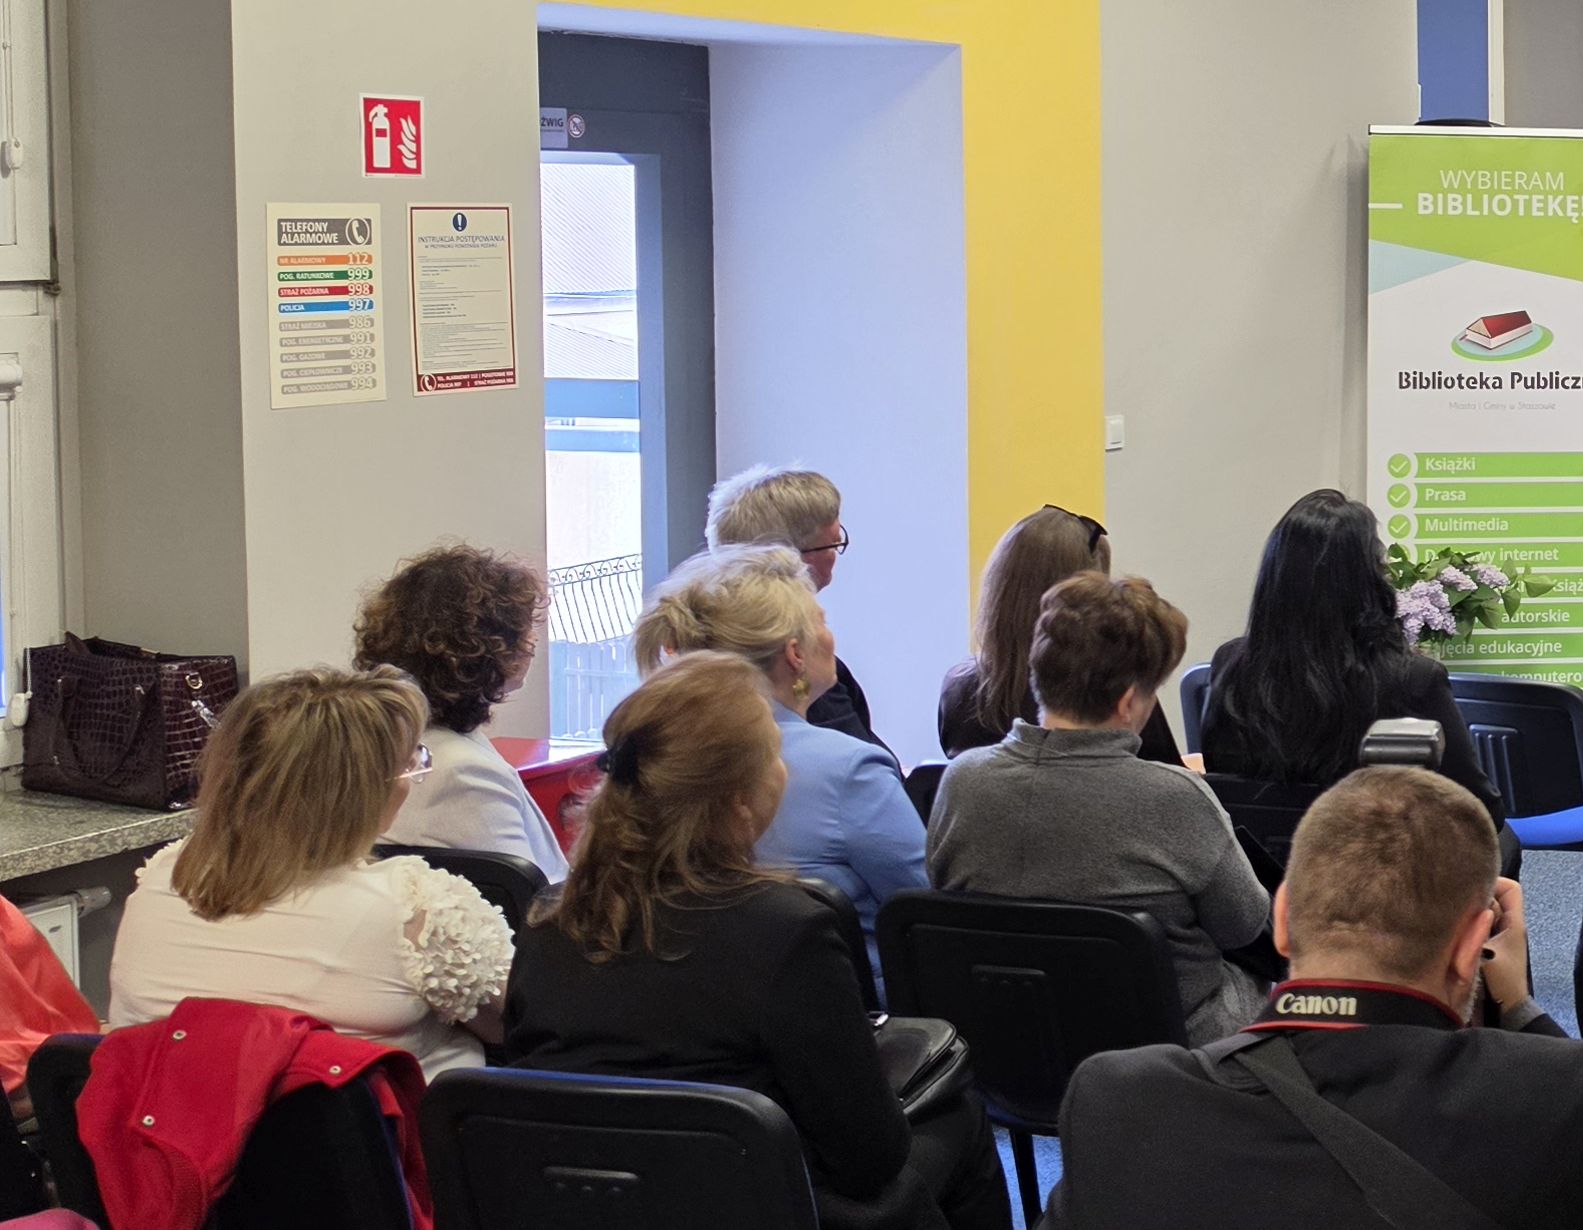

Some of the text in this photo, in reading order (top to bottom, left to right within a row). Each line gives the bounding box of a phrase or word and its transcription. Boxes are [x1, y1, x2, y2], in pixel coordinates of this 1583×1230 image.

[1440, 169, 1565, 191] WYBIERAM
[280, 222, 328, 233] TELEFONY
[280, 232, 339, 244] ALARMOWE
[347, 253, 369, 265] 112
[347, 268, 370, 280] 999
[347, 283, 370, 296] 998
[348, 299, 371, 311] 997
[348, 316, 371, 329] 986
[350, 332, 371, 344] 991
[350, 347, 372, 359] 992
[351, 362, 373, 375] 993
[351, 378, 374, 390] 994
[1398, 371, 1503, 390] Biblioteka
[1425, 457, 1476, 474] Książki
[1425, 488, 1467, 502] Prasa
[1425, 517, 1508, 532] Multimedia
[1500, 547, 1559, 561] internet
[1501, 609, 1570, 623] autorskie
[1479, 640, 1563, 660] edukacyjne
[1276, 993, 1357, 1015] Canon
